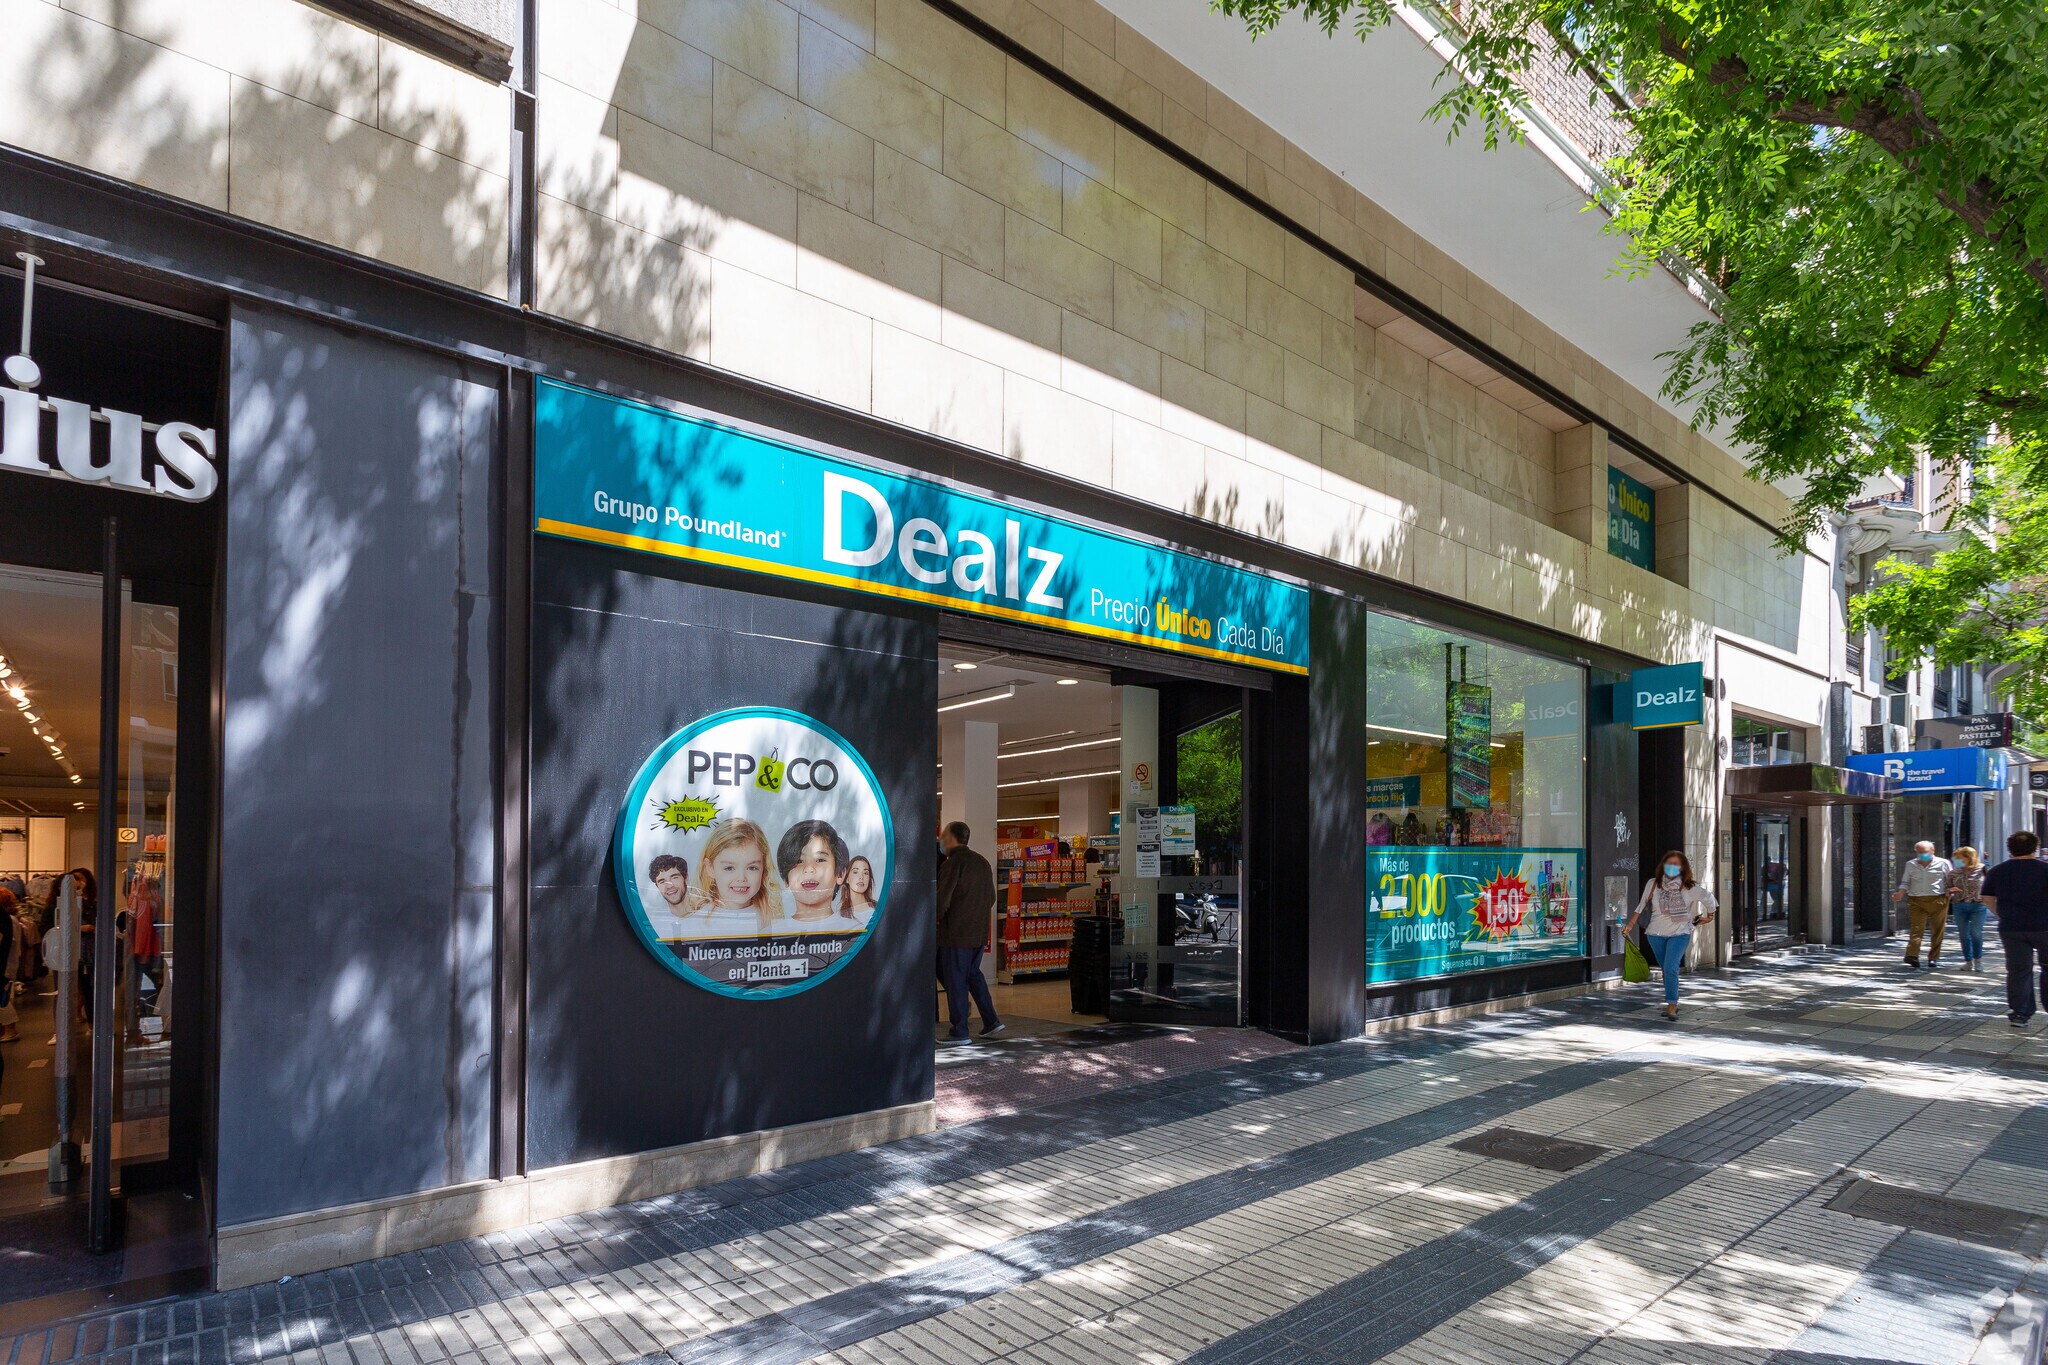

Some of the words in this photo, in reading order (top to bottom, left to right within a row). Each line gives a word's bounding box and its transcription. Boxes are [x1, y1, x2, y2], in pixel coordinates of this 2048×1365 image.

[1618, 478, 1650, 523] Único
[593, 490, 658, 524] Grupo
[823, 470, 1064, 609] Dealz
[1622, 518, 1640, 550] Día
[1090, 587, 1151, 628] Precio
[1156, 596, 1212, 640] Único
[1217, 616, 1257, 650] Cada
[1261, 626, 1285, 656] Día
[1635, 686, 1697, 708] Dealz
[1971, 716, 1989, 724] PAN
[1964, 724, 1997, 732] PASTAS
[1958, 731, 2002, 740] PASTELES
[1967, 739, 1992, 747] CAFÉ
[1921, 767, 1946, 775] travel
[1907, 774, 1932, 782] brand
[1373, 782, 1404, 792] marcas
[673, 805, 701, 813] EXCLUSIVO
[676, 813, 705, 823] Dealz
[1091, 839, 1106, 847] Dealz
[1002, 848, 1022, 859] NEW
[1379, 857, 1398, 872] Más
[1399, 857, 1409, 871] de
[1391, 918, 1456, 949] productos
[688, 946, 732, 961] Nueva
[735, 943, 787, 959] sección
[790, 941, 806, 956] de
[809, 940, 842, 954] moda
[728, 967, 746, 980] en
[749, 962, 791, 978] Planta
[794, 961, 807, 975] -1
